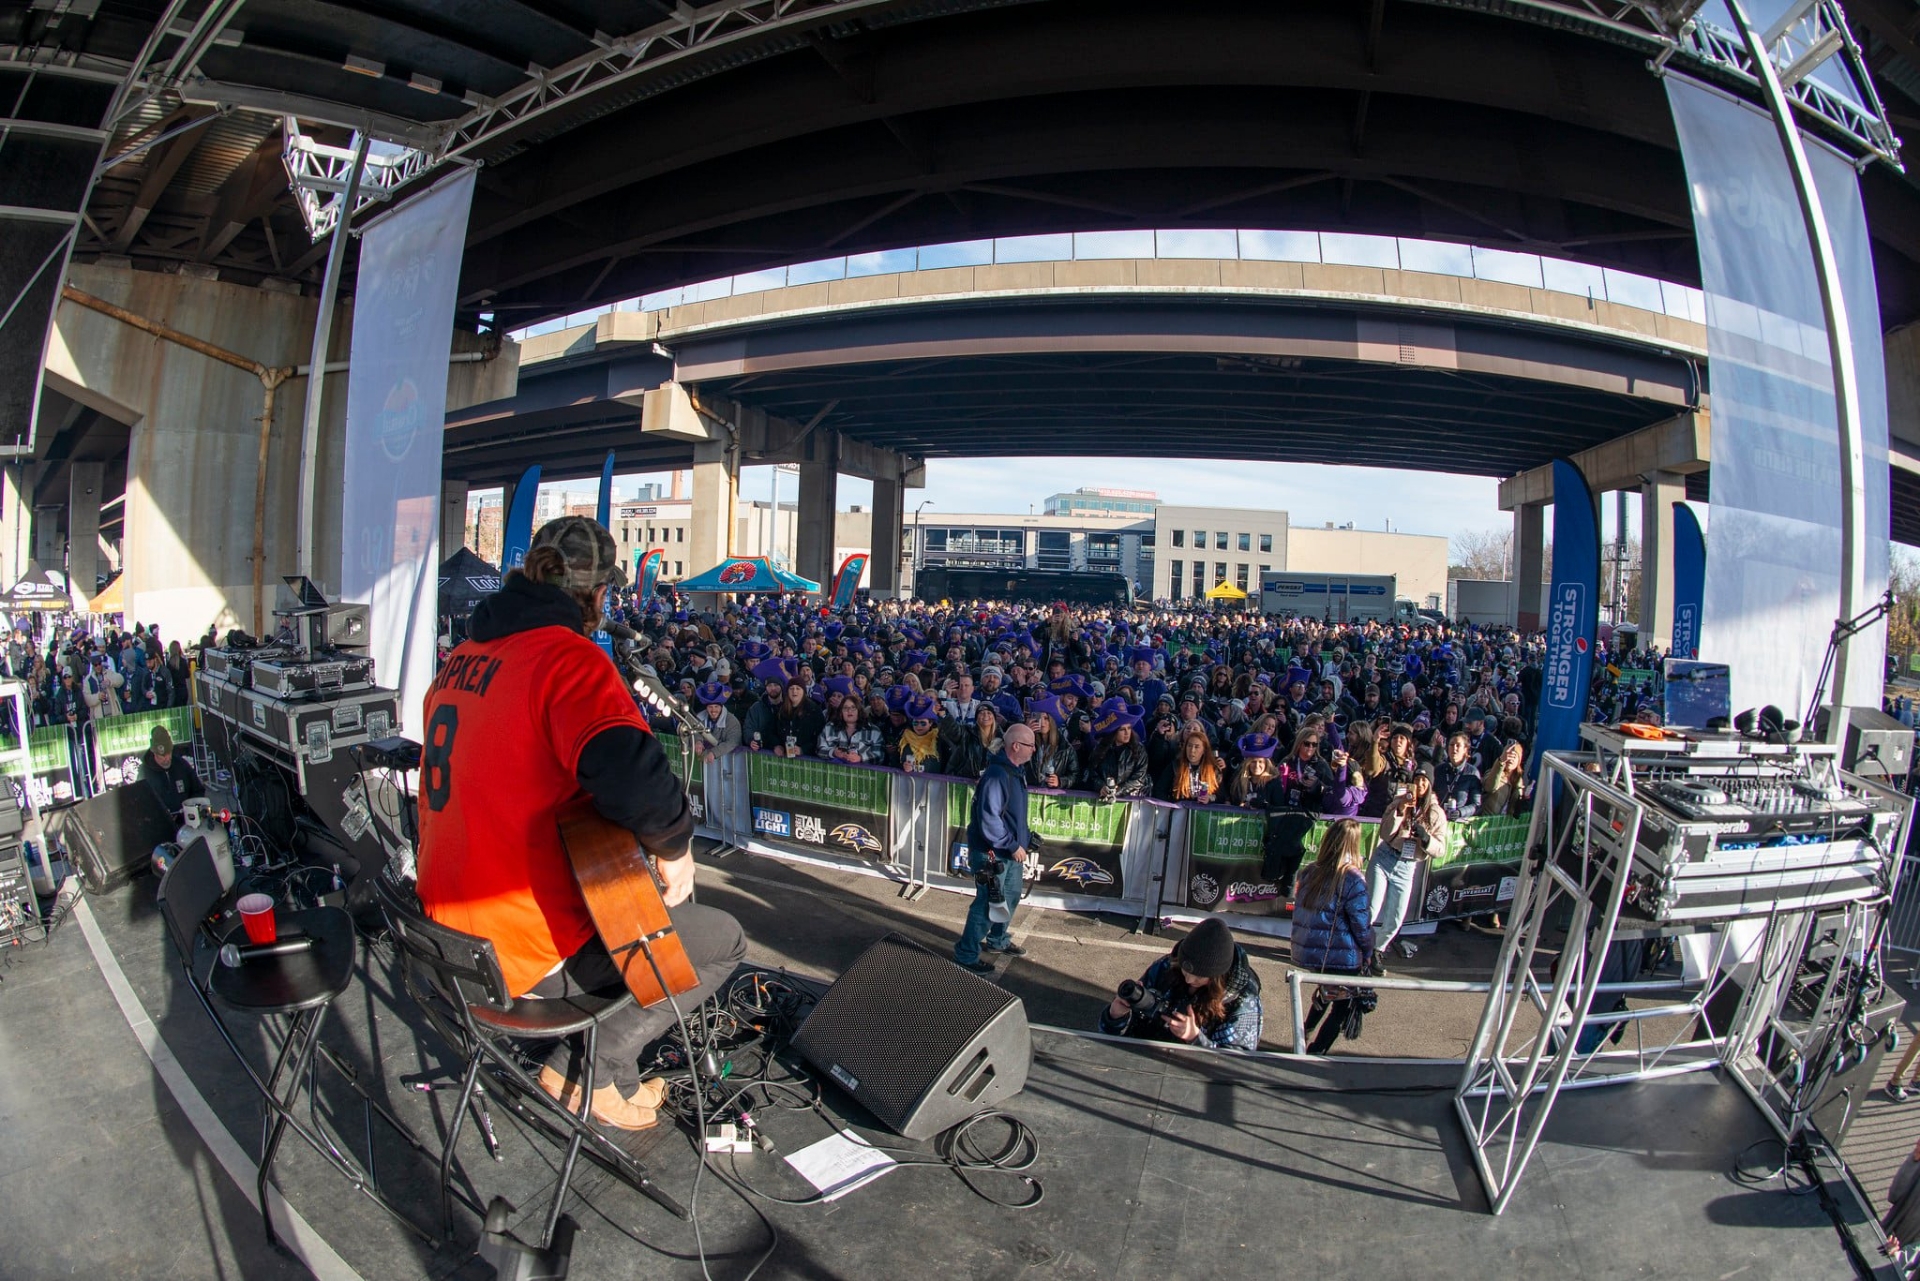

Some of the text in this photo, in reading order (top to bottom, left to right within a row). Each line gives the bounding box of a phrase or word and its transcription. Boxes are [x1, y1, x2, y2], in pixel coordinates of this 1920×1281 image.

[1547, 601, 1563, 686] TOGETHER
[424, 704, 458, 812] 8
[791, 781, 799, 789] 30
[802, 783, 810, 791] 40
[813, 785, 821, 793] 50
[824, 786, 832, 795] 40
[836, 788, 844, 797] 30
[847, 790, 856, 799] 20
[760, 810, 783, 823] BUD
[795, 813, 826, 835] TAIL
[1031, 817, 1100, 831] 50 40 30 20 10
[754, 819, 788, 834] LIGHT
[1717, 819, 1750, 834] serato
[1218, 838, 1228, 846] 10
[1232, 838, 1243, 847] 20
[1248, 838, 1258, 847] 30
[1201, 873, 1218, 886] CLAW
